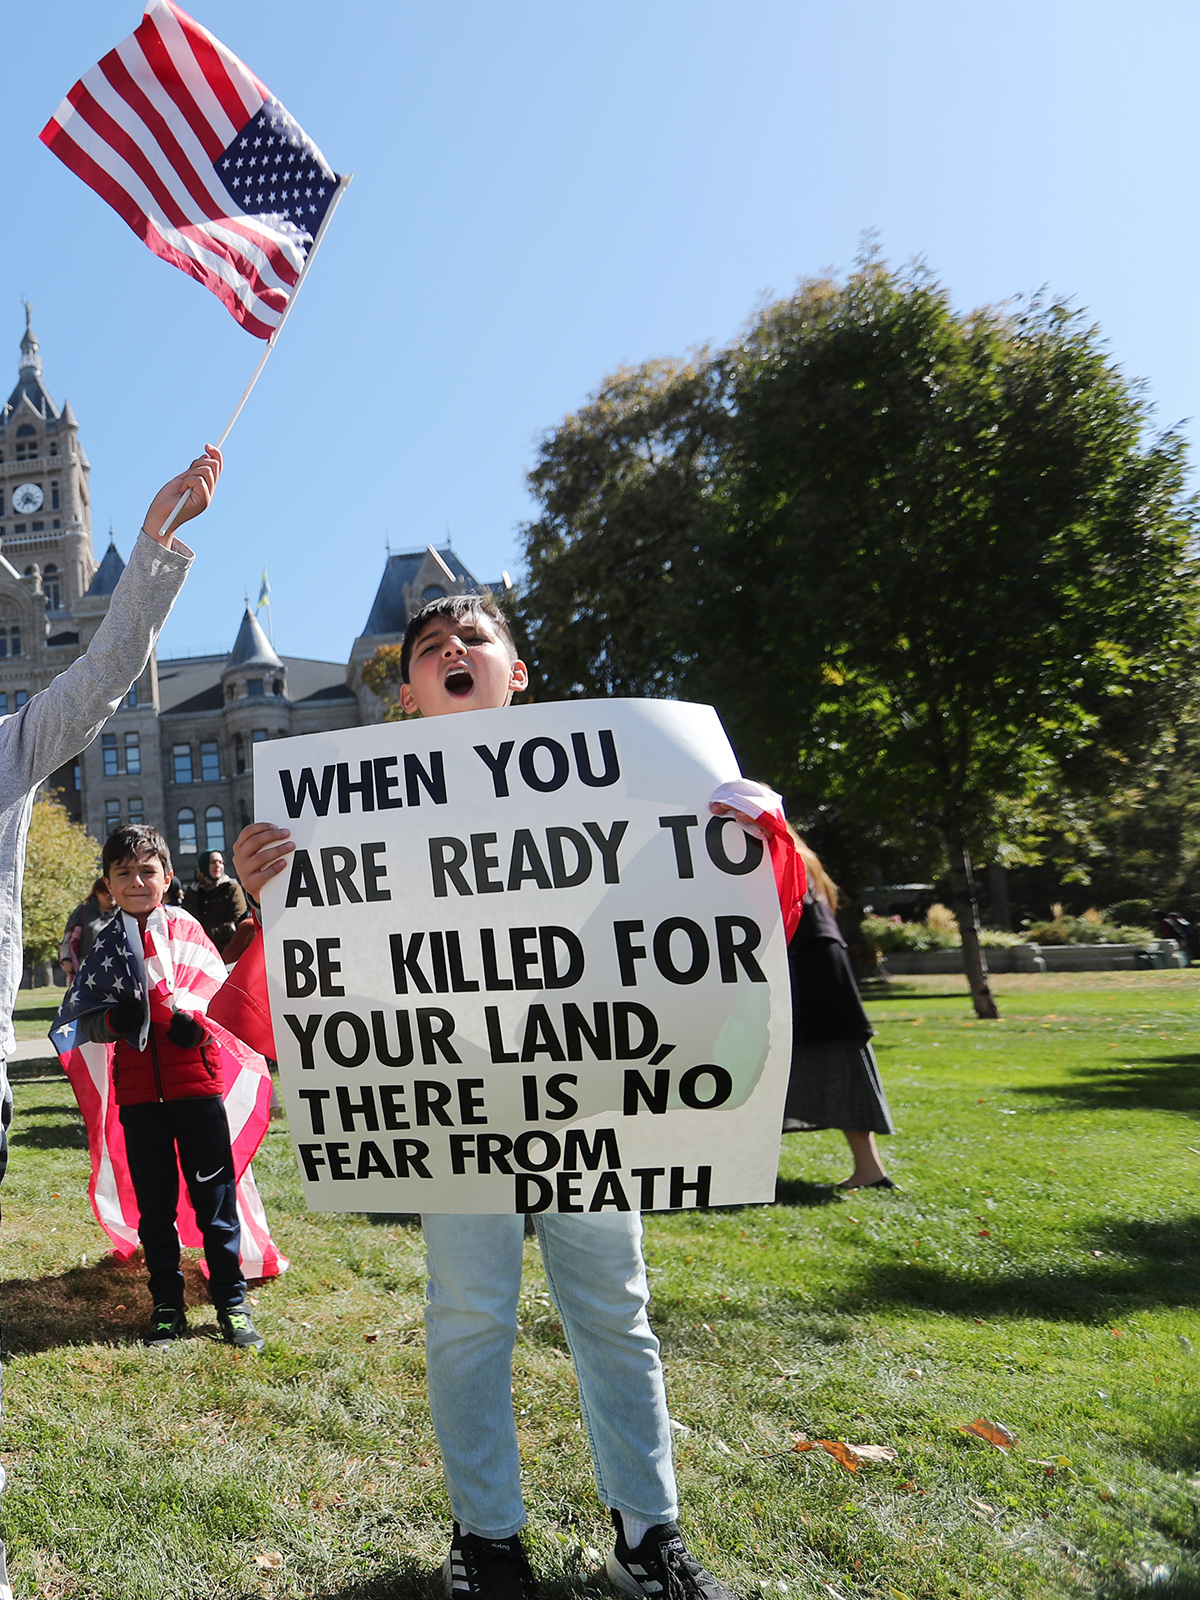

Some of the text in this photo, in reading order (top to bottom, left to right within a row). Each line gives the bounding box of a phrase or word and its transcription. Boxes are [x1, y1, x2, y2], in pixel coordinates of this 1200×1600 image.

[279, 729, 620, 819] WHEN YOU
[285, 815, 764, 908] ARE READY TO
[282, 915, 768, 998] BE KILLED FOR
[283, 1001, 677, 1070] YOUR LAND,
[298, 1064, 733, 1135] THERE IS NO
[298, 1128, 622, 1182] FEAR FROM
[514, 1165, 712, 1214] DEATH
